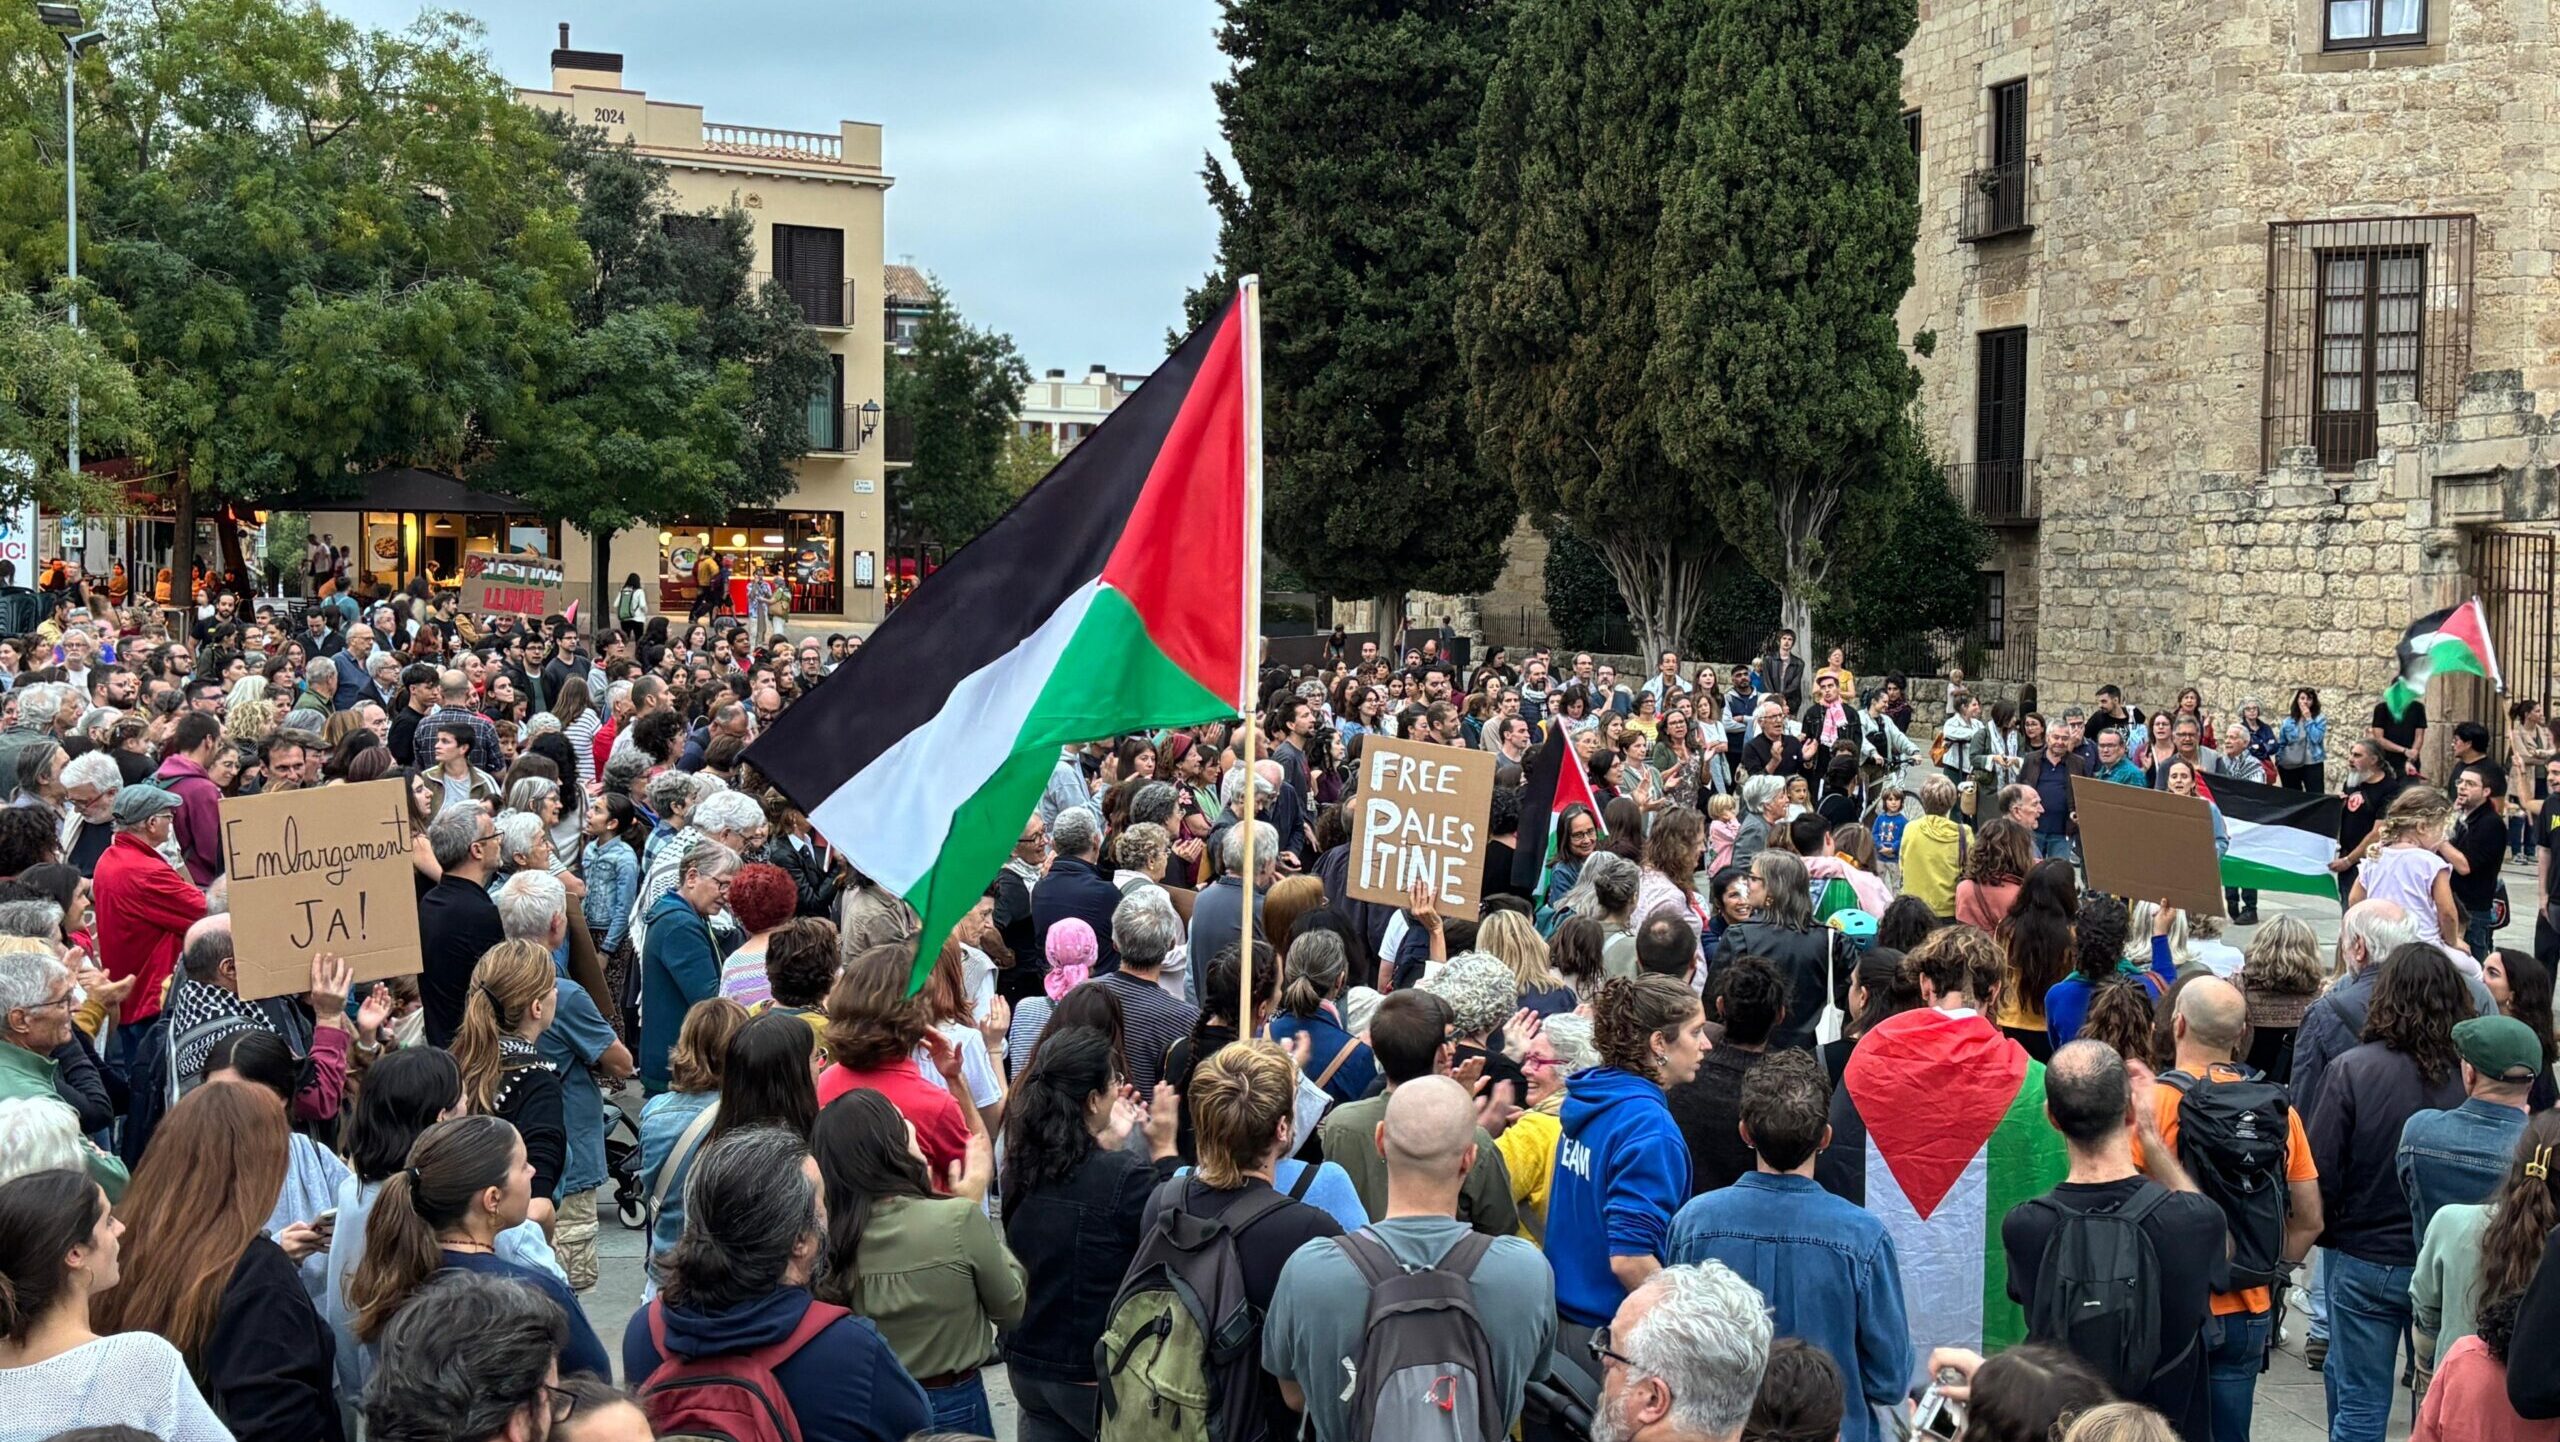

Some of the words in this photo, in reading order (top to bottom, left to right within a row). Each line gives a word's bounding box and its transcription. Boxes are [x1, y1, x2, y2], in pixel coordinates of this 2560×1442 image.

[594, 107, 625, 124] 2024
[1370, 751, 1462, 795] FREE
[226, 804, 414, 885] Embargament
[290, 891, 367, 948] JA!
